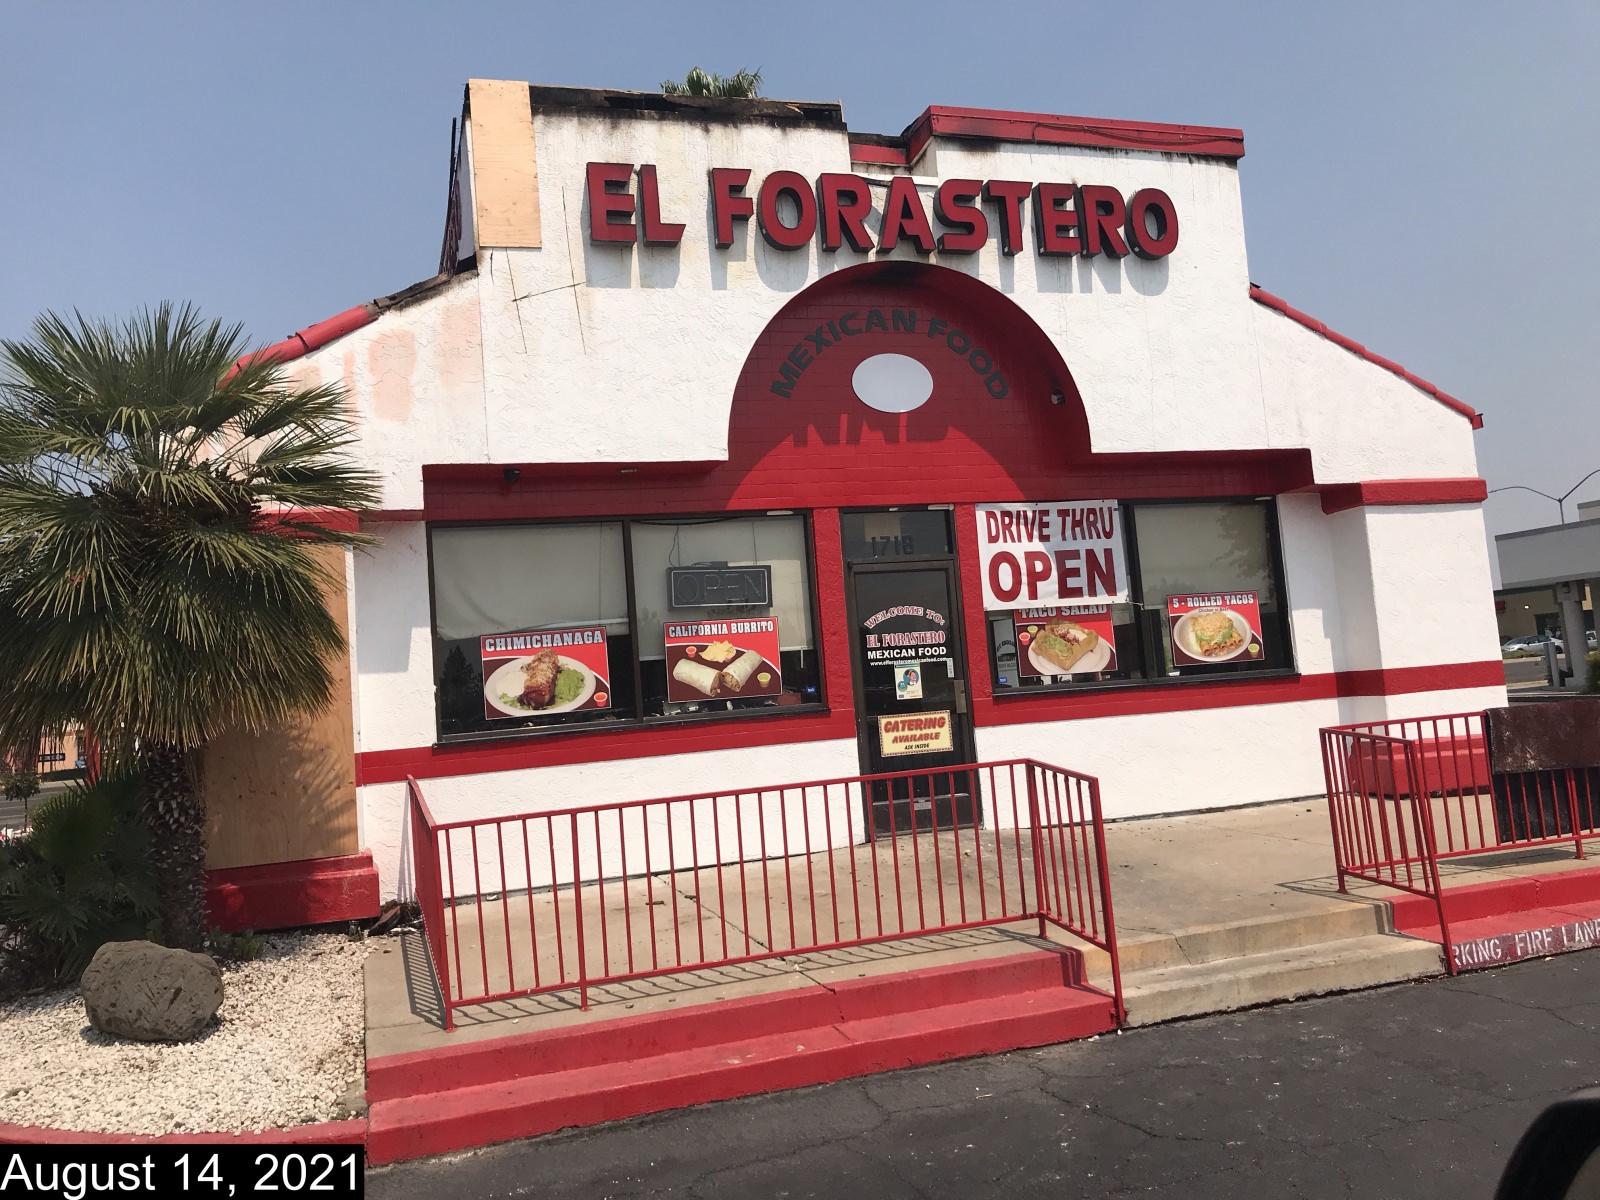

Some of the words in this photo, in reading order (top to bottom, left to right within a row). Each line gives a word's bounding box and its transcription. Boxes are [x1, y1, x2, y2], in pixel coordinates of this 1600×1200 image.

[584, 161, 687, 247] EL
[709, 167, 1180, 260] FORASTERO
[770, 309, 916, 399] MEXICAN
[927, 317, 1008, 400] FOOD
[985, 508, 1051, 545] DRIVE
[1056, 506, 1114, 543] THRU
[871, 535, 913, 556] 1718
[988, 548, 1118, 602] OPEN
[676, 573, 763, 602] OPEN
[1019, 606, 1057, 618] TACO
[1061, 604, 1107, 616] SALAD
[1173, 598, 1180, 609] 5
[1187, 595, 1222, 608] ROLLED
[1225, 594, 1254, 605] TACOS
[864, 606, 924, 629] WELCOME
[668, 623, 728, 638] CALIFORNIA
[731, 620, 774, 635] BURRITO
[866, 634, 880, 648] EL
[882, 630, 946, 647] FORASTERO
[485, 630, 604, 652] CHIMICHANAGA
[868, 648, 916, 660] MEXICAN
[918, 646, 946, 656] FOOD
[884, 716, 946, 733] CATERING
[892, 732, 941, 744] AVAILABLE
[1515, 928, 1553, 956] FIRE
